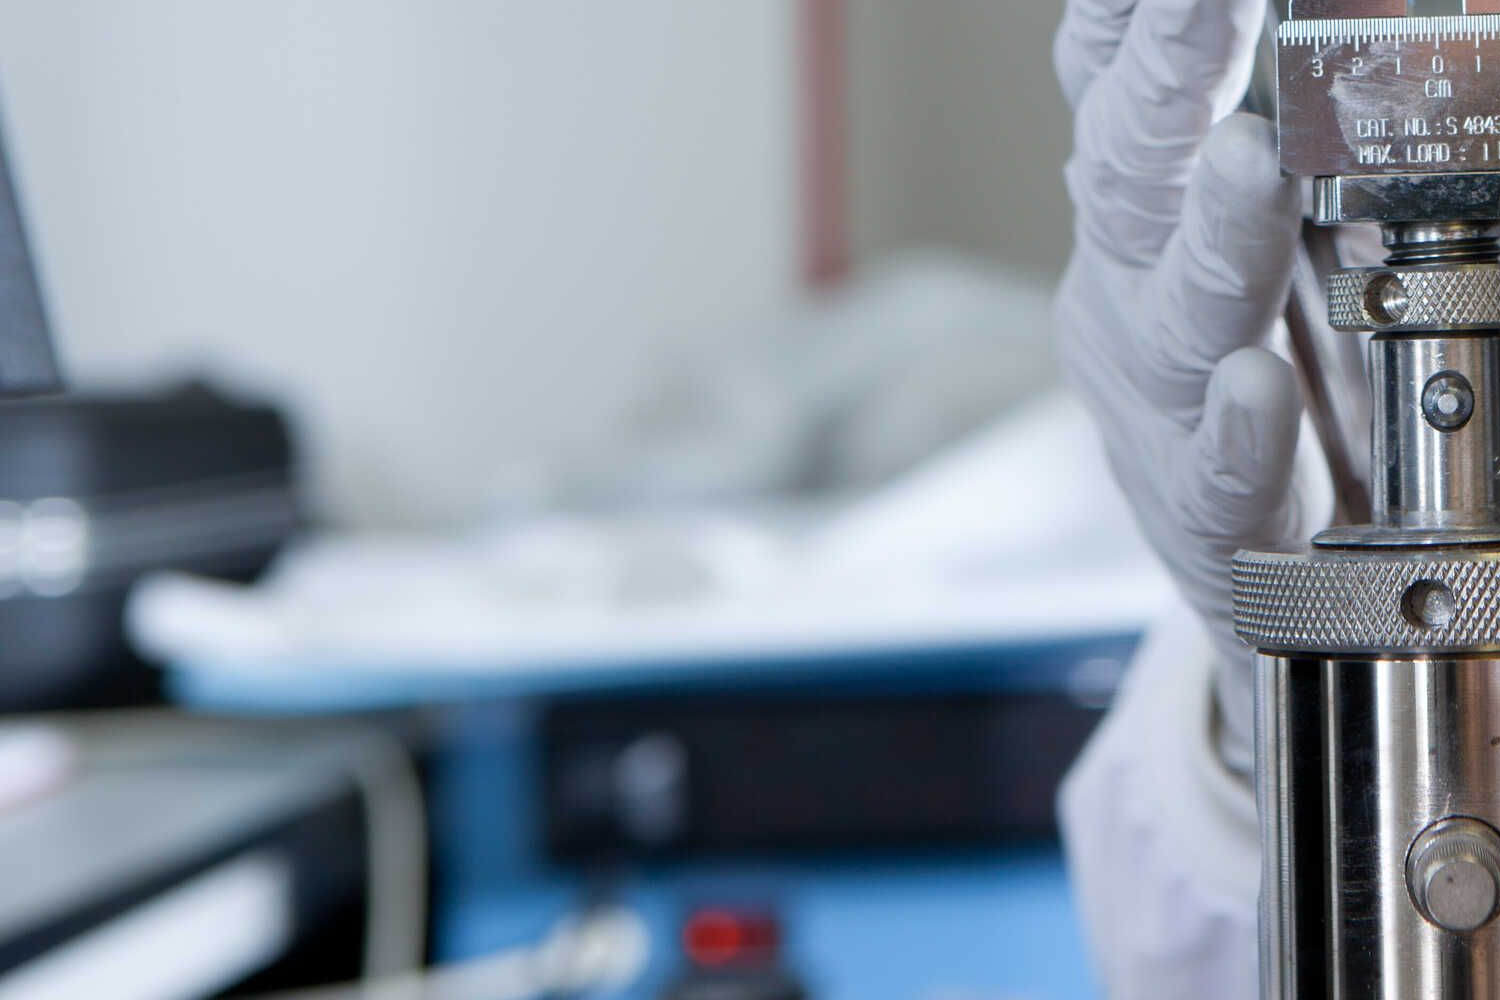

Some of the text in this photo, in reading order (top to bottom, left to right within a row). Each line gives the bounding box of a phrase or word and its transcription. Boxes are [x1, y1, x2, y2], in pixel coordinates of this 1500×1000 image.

[1311, 58, 1324, 78] 3
[1351, 57, 1363, 75] 2
[1394, 56, 1401, 75] 1
[1431, 55, 1444, 74] 0
[1475, 55, 1481, 73] 1
[1356, 118, 1394, 137] CAT.
[1359, 144, 1396, 164] MAX.
[1407, 142, 1450, 163] LOAD
[1483, 142, 1489, 161] 1
